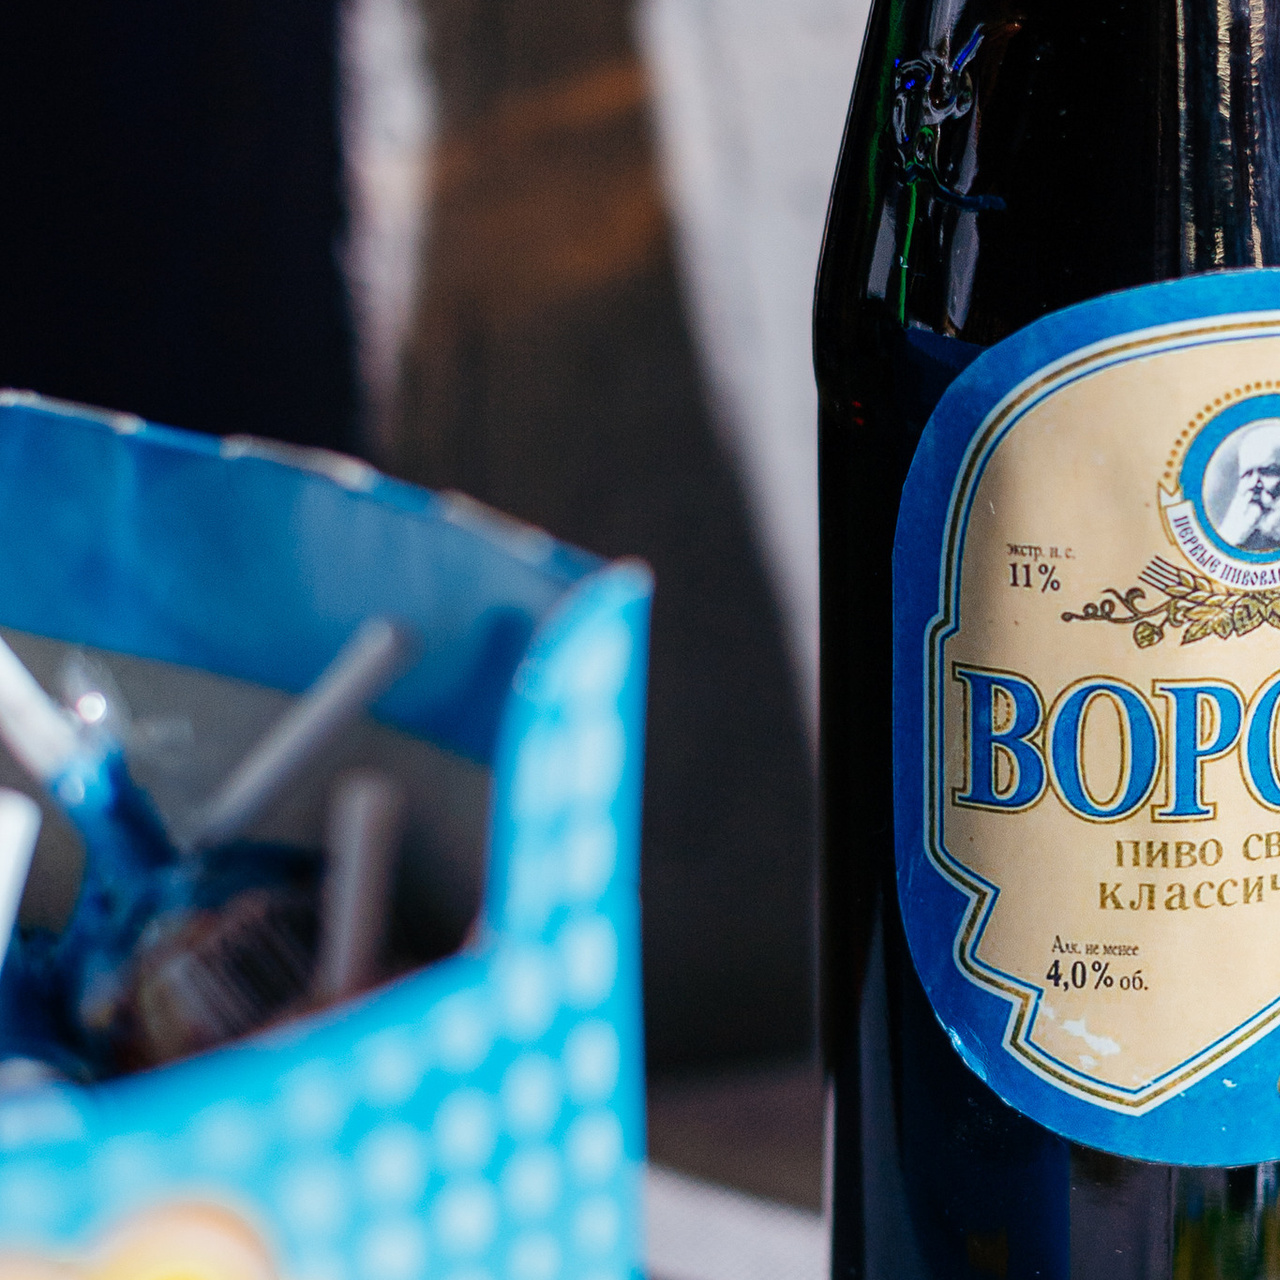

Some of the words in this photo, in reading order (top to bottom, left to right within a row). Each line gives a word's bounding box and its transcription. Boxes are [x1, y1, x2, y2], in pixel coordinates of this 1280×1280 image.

[1008, 561, 1061, 594] 11%
[1115, 837, 1224, 869] пиво
[1084, 942, 1101, 956] не
[1045, 959, 1115, 993] 4,0%
[1119, 969, 1150, 991] об.
